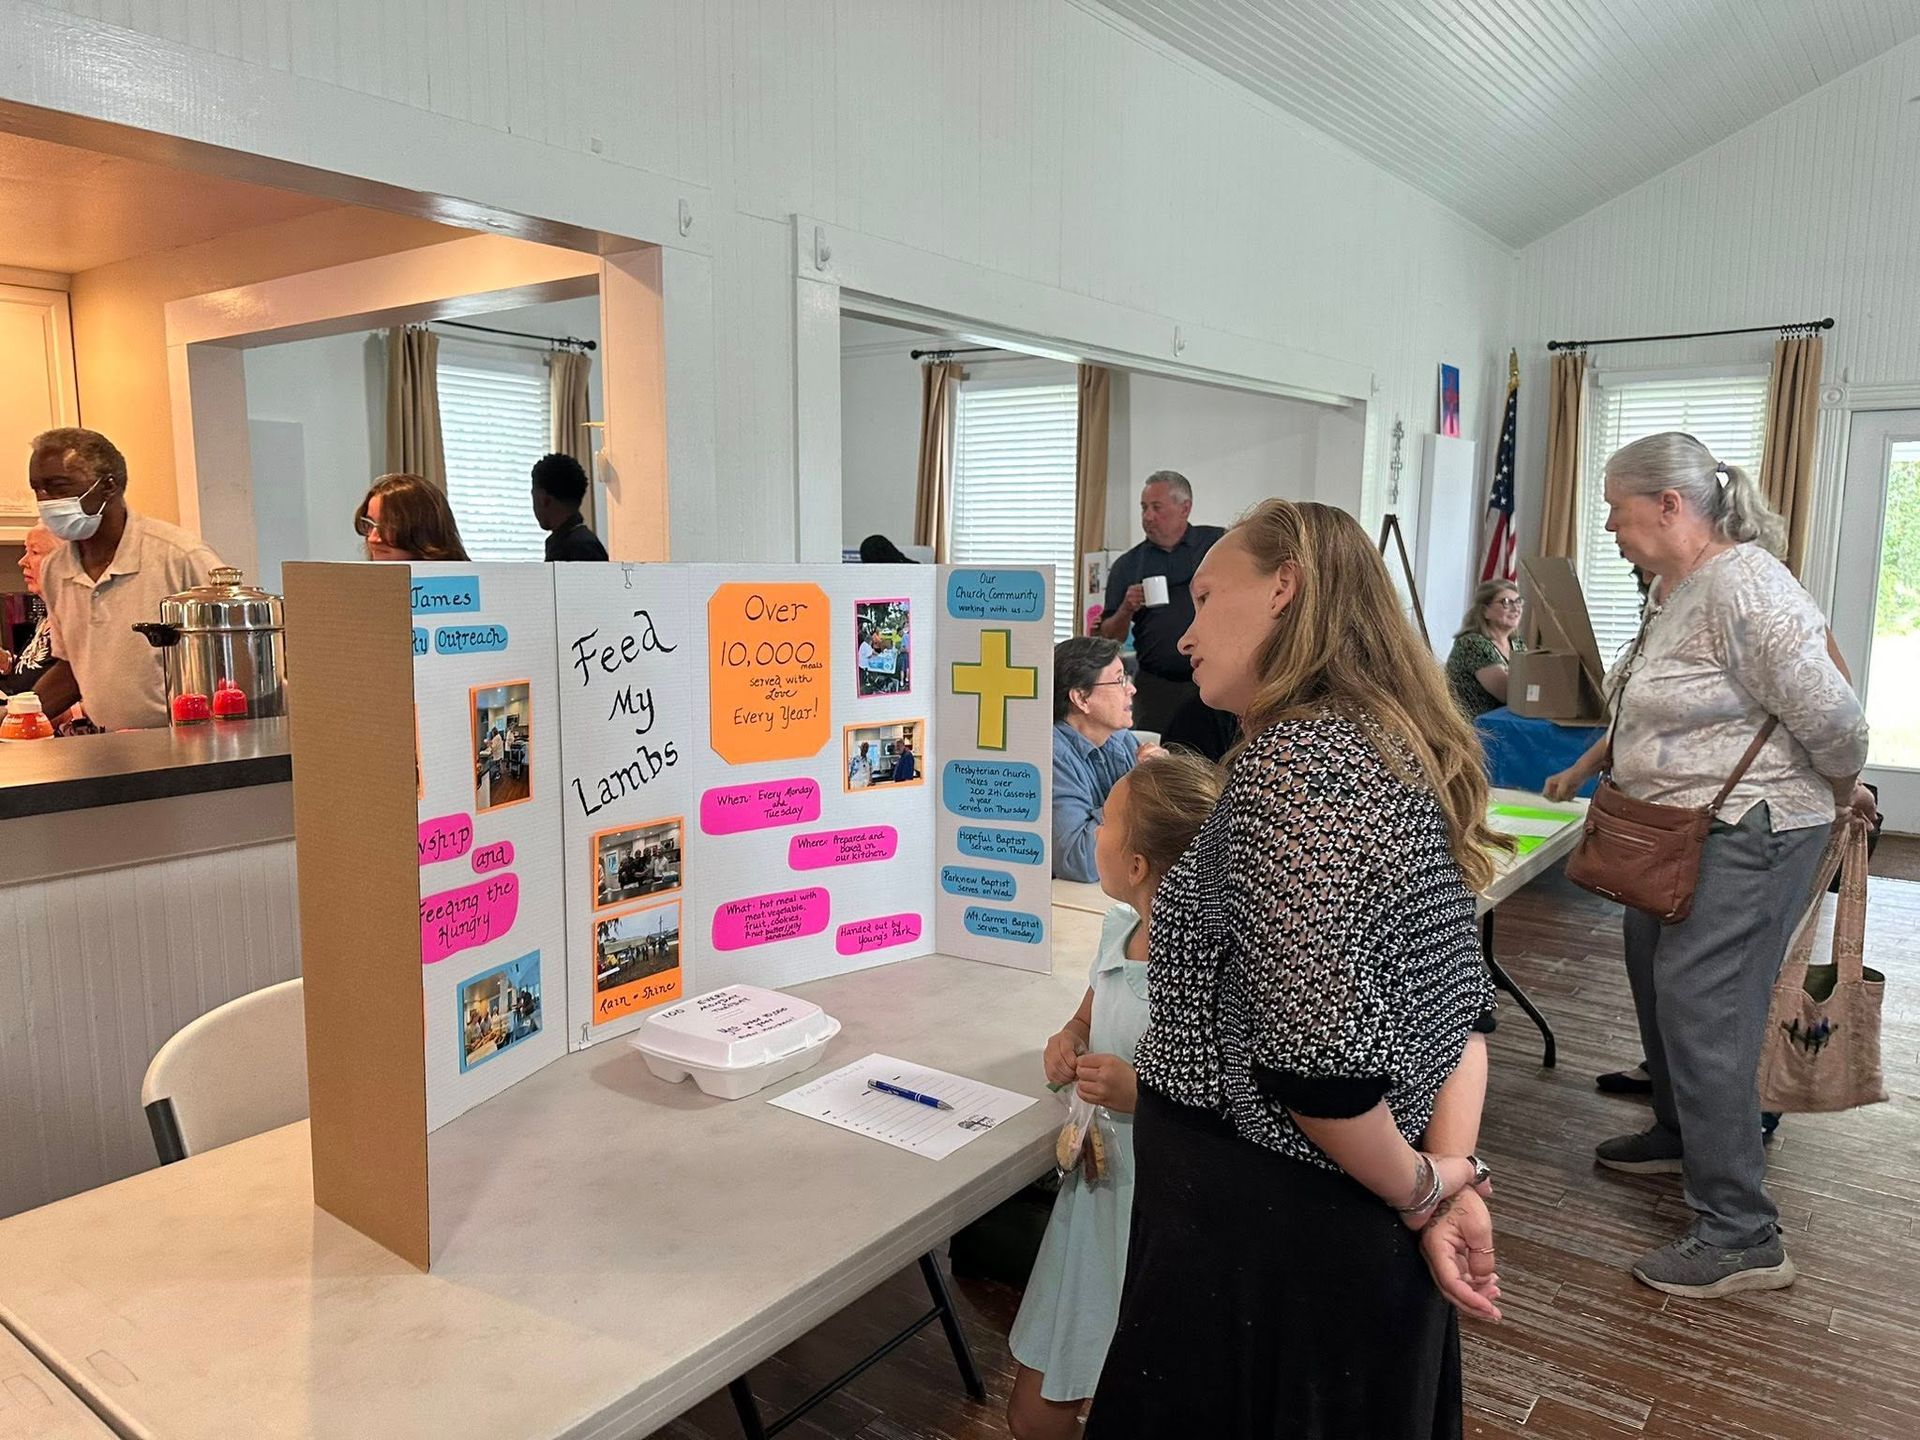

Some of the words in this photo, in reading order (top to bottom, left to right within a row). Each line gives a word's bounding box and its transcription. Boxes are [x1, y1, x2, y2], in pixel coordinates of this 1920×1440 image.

[979, 572, 996, 584] Our
[411, 586, 471, 608] James
[955, 586, 990, 602] Church
[745, 595, 808, 622] Over
[958, 605, 985, 618] working
[990, 605, 1007, 613] with
[438, 628, 507, 650] Outreach
[572, 610, 678, 686] Feed
[721, 641, 815, 667] 10,000
[801, 661, 823, 669] meals
[750, 675, 782, 687] served
[785, 675, 813, 684] with
[765, 687, 798, 700] Love
[608, 685, 655, 734] My
[734, 707, 774, 732] Every
[780, 697, 818, 729] Year!
[572, 741, 678, 816] Lambs
[954, 763, 1000, 778] Presbyterian
[1002, 768, 1031, 779] Church
[965, 778, 988, 786] makes
[758, 790, 781, 800] Every
[785, 786, 814, 799] Monday
[970, 787, 985, 796] 200
[976, 798, 992, 807] year
[764, 806, 803, 821] Tuesday
[996, 805, 1030, 818] Thursday
[833, 833, 867, 846] Prepared
[868, 832, 885, 840] and
[959, 831, 991, 845] Hopeful
[996, 834, 1027, 847] Baptist
[835, 854, 850, 862] our
[852, 850, 887, 860] kitchen
[841, 844, 863, 853] boxed
[1009, 846, 1040, 863] Thursday
[476, 847, 510, 868] and
[981, 876, 1010, 890] Baptist
[487, 882, 513, 902] the
[760, 899, 774, 909] hot
[776, 895, 796, 905] meal
[800, 891, 817, 900] with
[840, 923, 872, 936] Handed
[875, 922, 888, 930] out
[891, 920, 901, 928] by
[981, 913, 1008, 925] Carmel
[1012, 917, 1040, 930] Baptist
[438, 912, 490, 948] Hungry
[1002, 926, 1035, 943] Thursday
[858, 931, 888, 952] Young's
[892, 925, 920, 937] Park
[600, 999, 631, 1014] Rain
[642, 982, 675, 999] Shine
